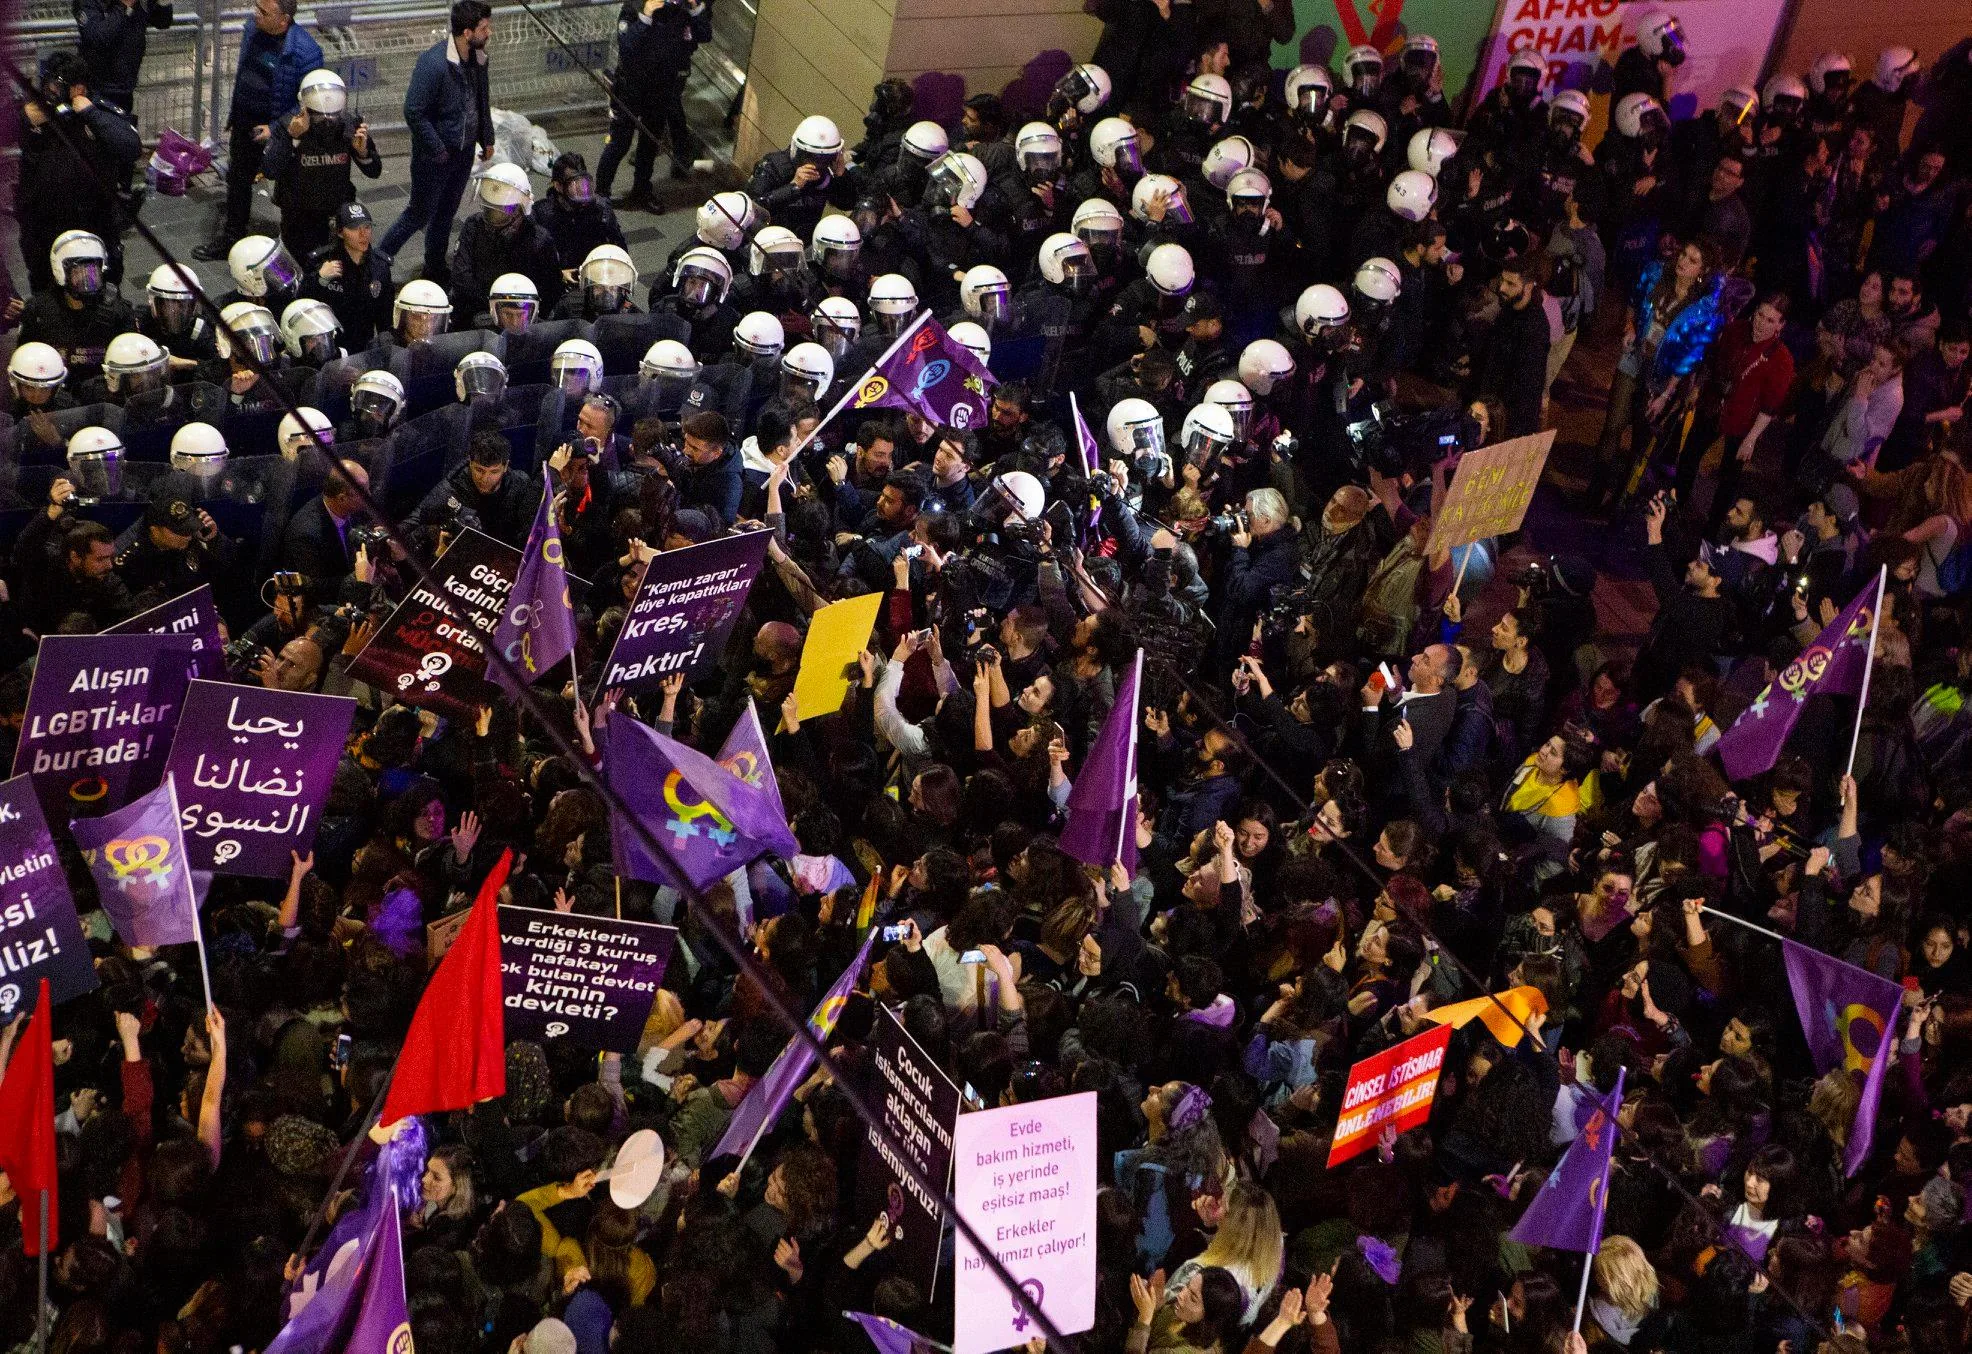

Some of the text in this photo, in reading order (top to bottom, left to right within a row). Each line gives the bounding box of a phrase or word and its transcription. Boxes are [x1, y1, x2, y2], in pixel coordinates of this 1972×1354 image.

[1506, 23, 1637, 54] CHAM-
[634, 578, 751, 615] diye kapattıkları
[624, 612, 690, 641] kreş,
[69, 666, 150, 694] Alışın
[606, 642, 706, 686] haktır!
[30, 701, 172, 739] LGBTİ+lar
[226, 696, 304, 750] يحيا
[33, 734, 154, 774] burada!
[193, 753, 305, 797] نضالنا
[501, 933, 658, 966] verdiği 3 kuruş
[527, 921, 640, 947] Erkeklerin
[500, 961, 657, 993] ok bulan devlet
[531, 952, 619, 974] nafakayı
[525, 978, 606, 1003] kimin
[504, 993, 619, 1021] devleti?
[897, 1045, 934, 1101] Çocuk
[1343, 1046, 1445, 1109] CİNSEL İSTİSMAR
[886, 1092, 932, 1156] aklayan
[1010, 1119, 1042, 1138] Evde
[976, 1135, 1076, 1167] bakım hizmeti,
[868, 1124, 939, 1221] istemiyoruz!
[993, 1162, 1059, 1189] iş yerinde
[982, 1181, 1070, 1213] eşitsiz maaş!
[996, 1217, 1056, 1242] Erkekler
[964, 1232, 1087, 1272] haytımızı çalıyor!
